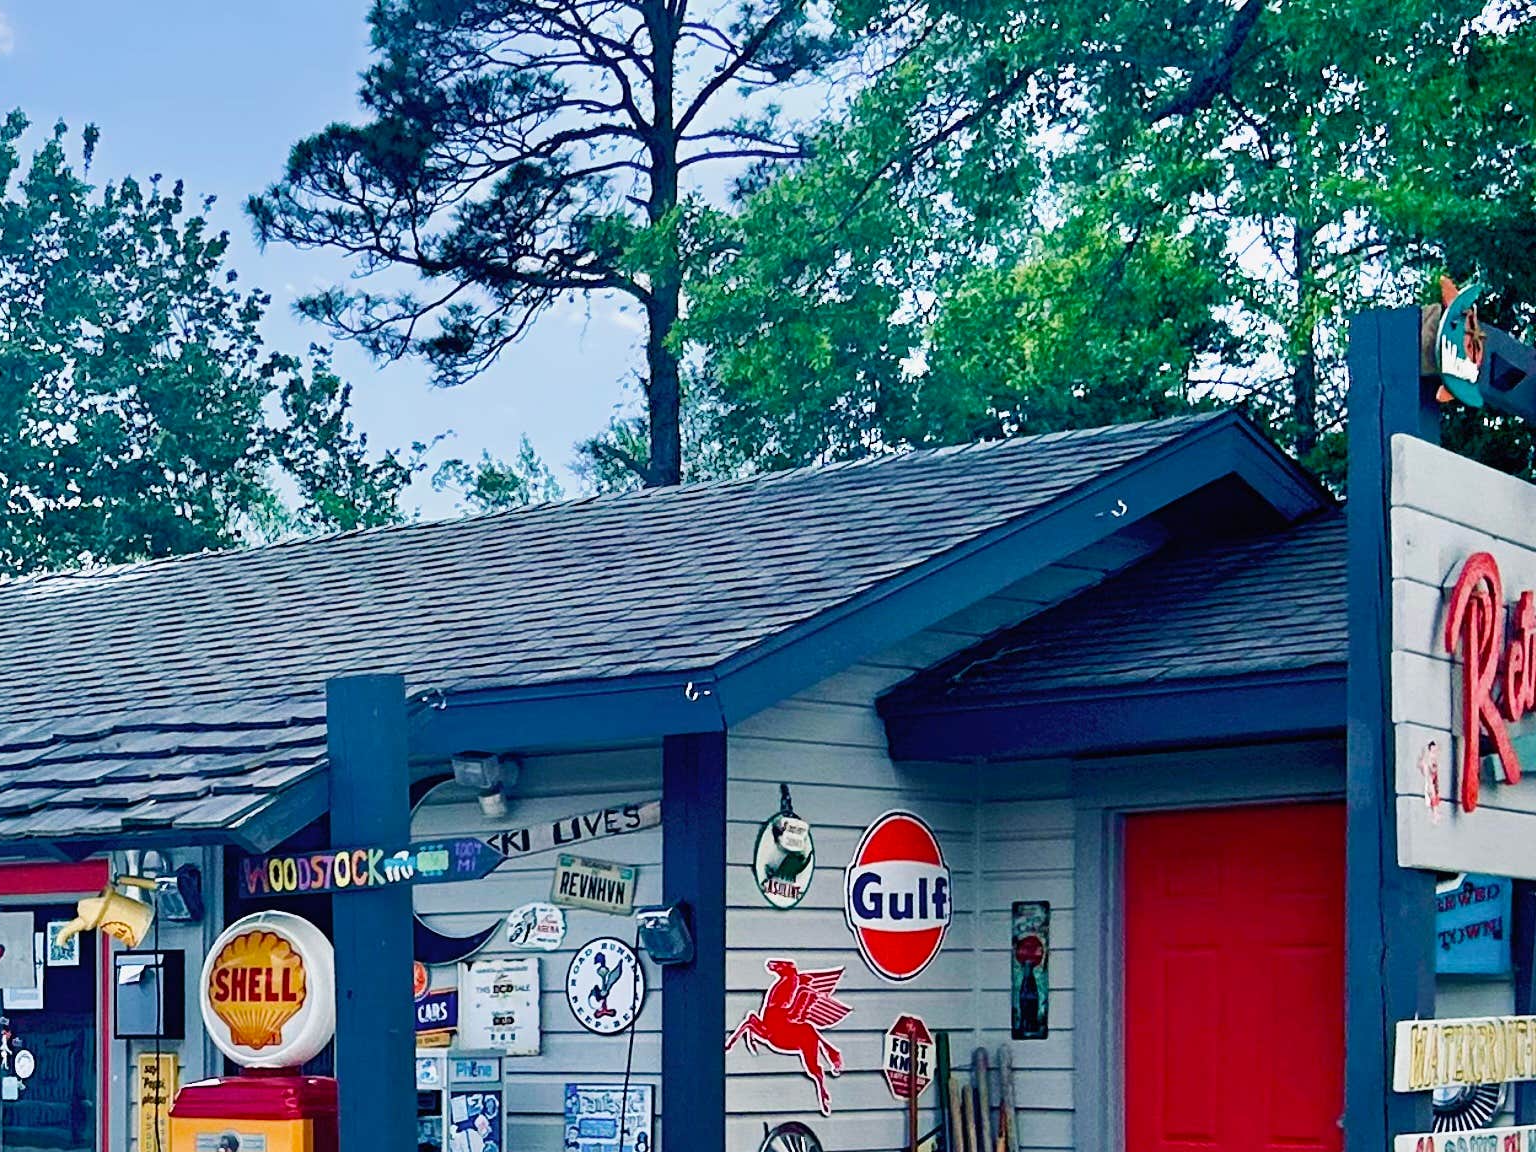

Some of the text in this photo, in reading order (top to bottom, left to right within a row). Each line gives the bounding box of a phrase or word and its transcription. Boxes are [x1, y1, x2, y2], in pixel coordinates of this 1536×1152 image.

[553, 805, 640, 845] LIVES
[244, 848, 386, 894] WOODSTOCK
[559, 871, 626, 905] REVNHVN
[852, 872, 948, 920] Gulf
[214, 966, 297, 1002] SHELL
[418, 1001, 448, 1023] CARS
[889, 1053, 929, 1076] KNX
[892, 1037, 929, 1059] FOT
